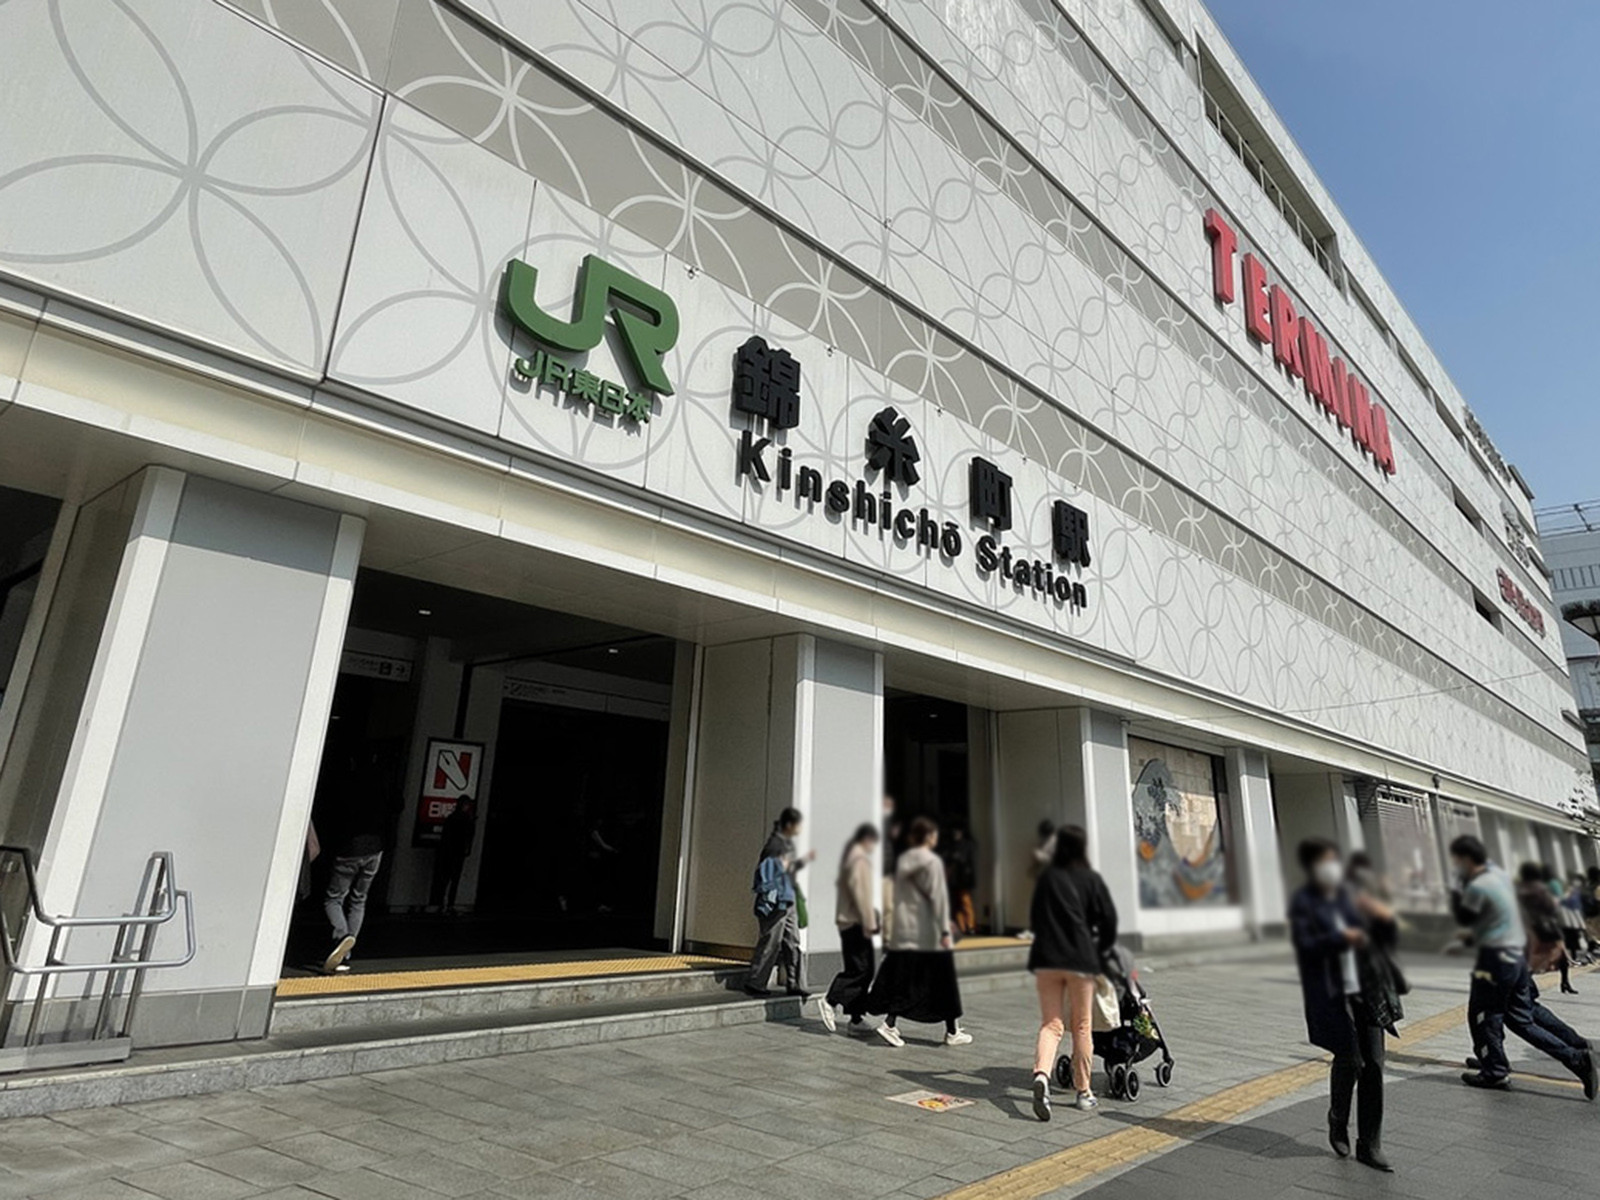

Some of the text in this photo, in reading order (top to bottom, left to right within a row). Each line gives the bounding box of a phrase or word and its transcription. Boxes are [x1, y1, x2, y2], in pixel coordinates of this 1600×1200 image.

[505, 253, 681, 397] JR
[514, 350, 651, 424] JR東日本
[1205, 207, 1396, 475] TERMINA
[735, 335, 1091, 568] 錦糸町駅
[976, 535, 1087, 608] Station
